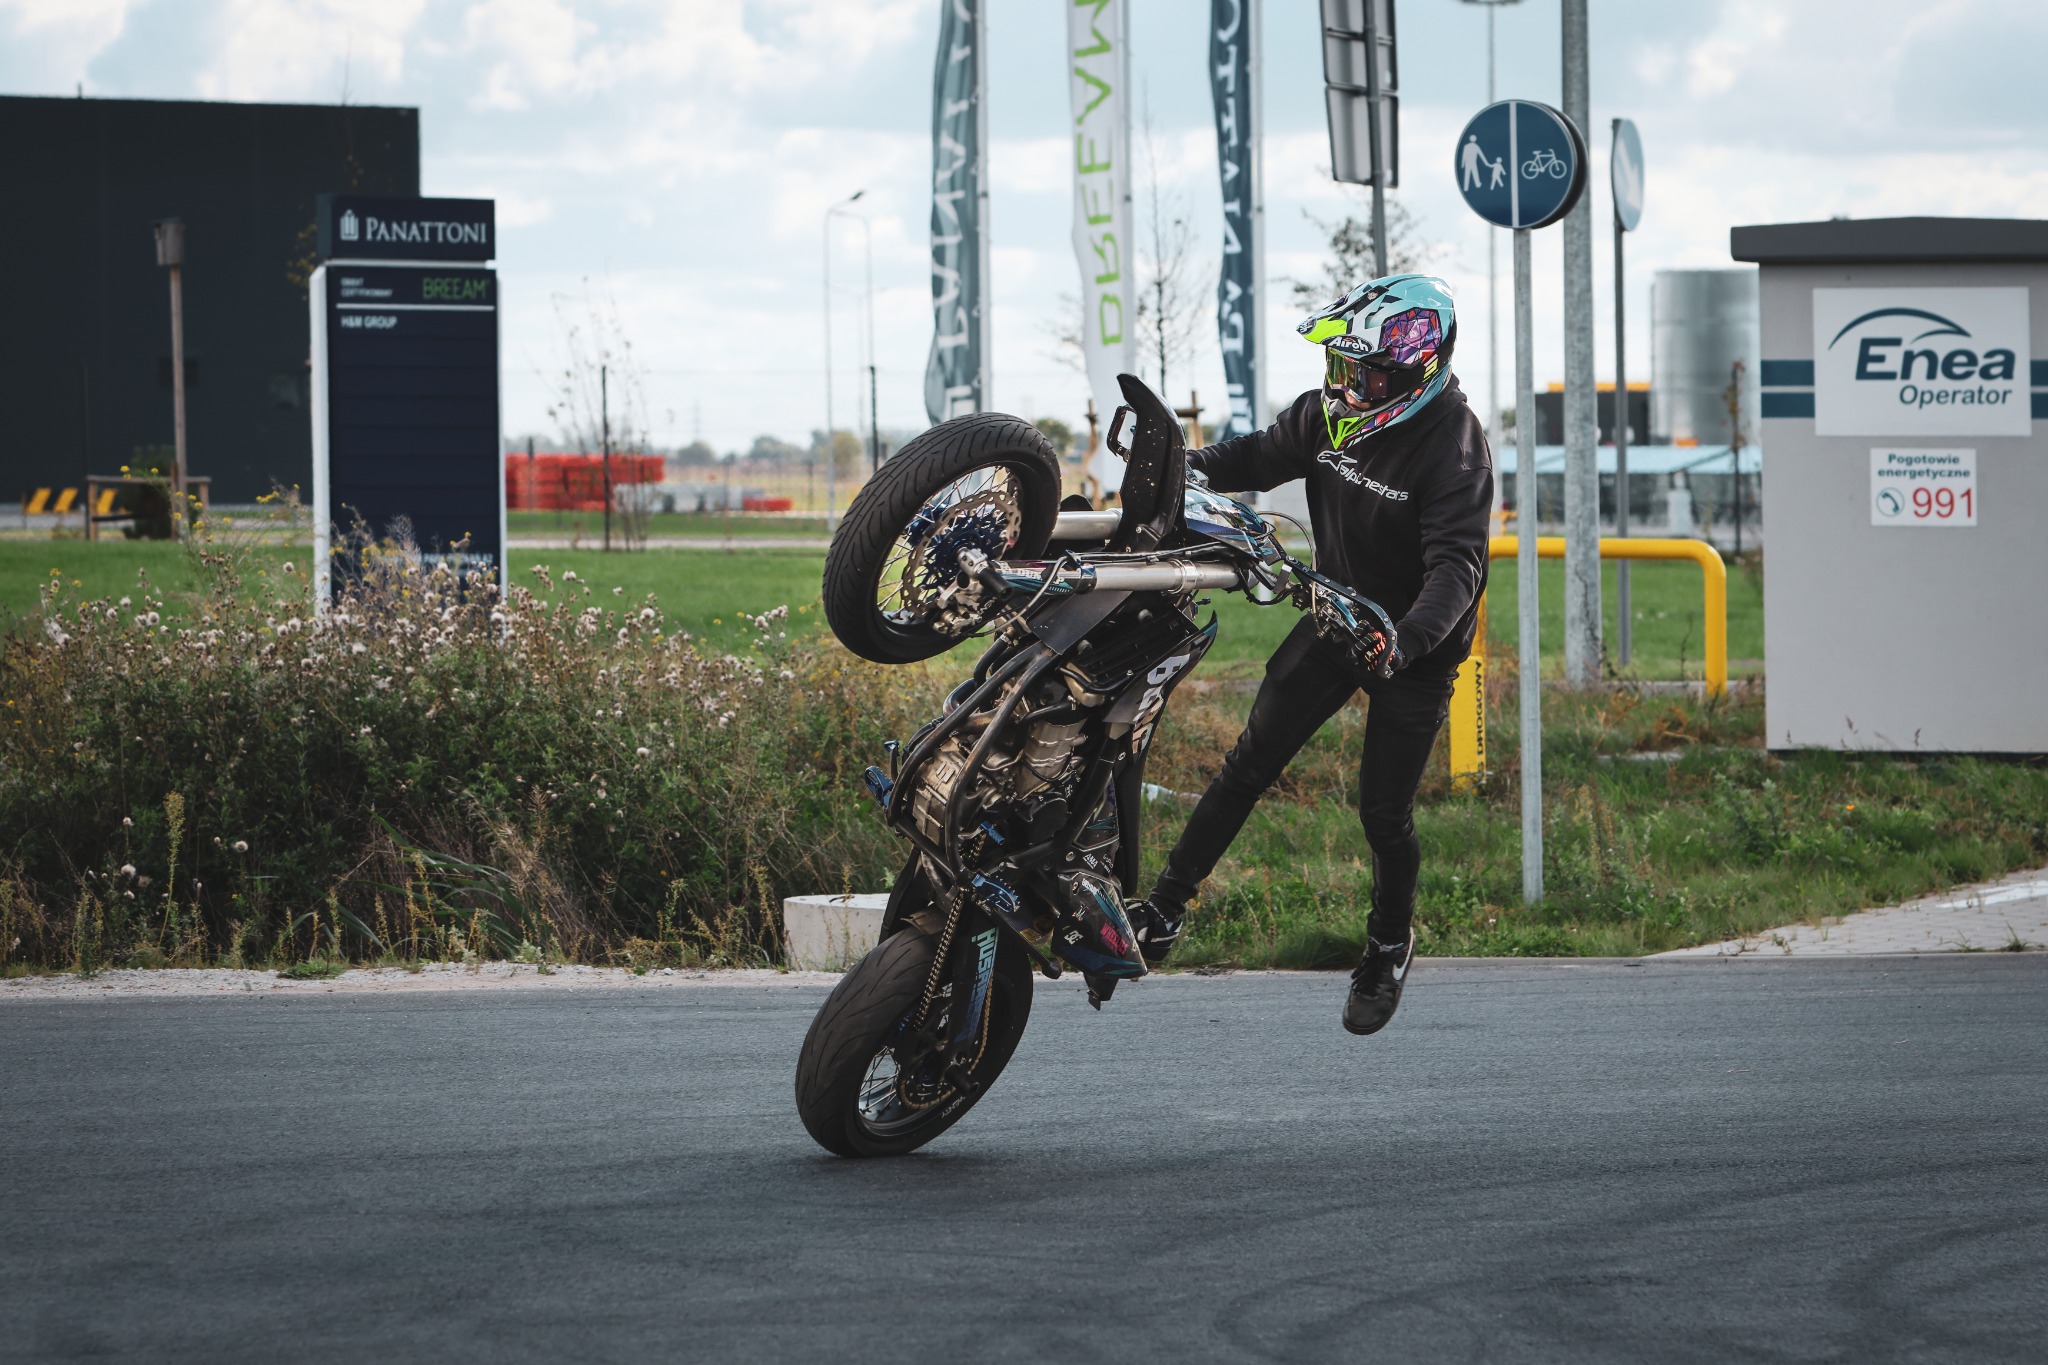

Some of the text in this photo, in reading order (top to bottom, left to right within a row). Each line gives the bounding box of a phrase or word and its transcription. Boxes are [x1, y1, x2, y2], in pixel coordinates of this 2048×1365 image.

[365, 217, 487, 244] PANATTONI
[422, 278, 487, 300] BREEAM
[364, 315, 398, 329] GROUP
[1328, 336, 1369, 352] Airoh
[1855, 337, 2016, 381] Enea
[1899, 384, 2012, 410] Operator
[1887, 453, 1960, 466] Pogotowie
[1340, 464, 1409, 501] alpinestars
[1877, 467, 1971, 479] energetyczne
[1912, 487, 1973, 518] 991
[1475, 660, 1484, 755] DROGOWY
